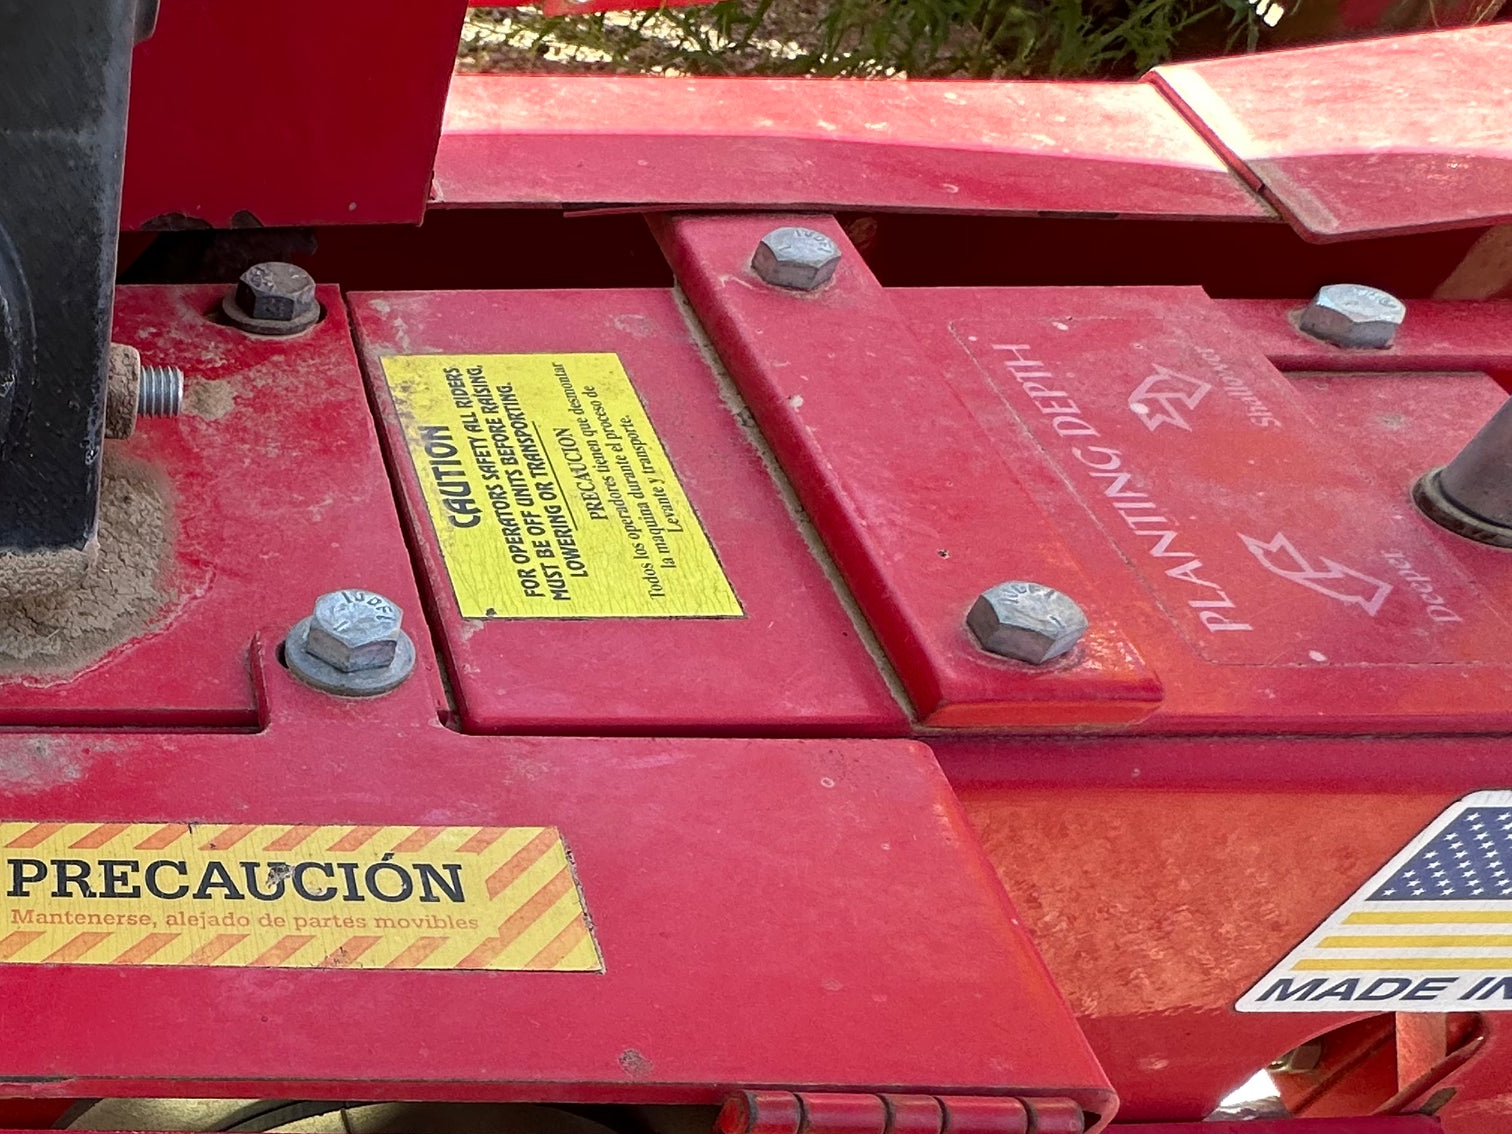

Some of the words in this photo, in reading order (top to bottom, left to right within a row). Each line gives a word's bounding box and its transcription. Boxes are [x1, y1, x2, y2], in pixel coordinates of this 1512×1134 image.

[443, 367, 476, 408] RIDERS
[552, 362, 585, 415] desmontar
[581, 385, 600, 398] de
[992, 343, 1099, 437] DEPTH
[1196, 345, 1282, 429] Shallower
[459, 412, 484, 432] ALL
[499, 382, 550, 478] TRANSPORTING.
[579, 418, 600, 436] que
[590, 401, 623, 439] proceso
[467, 436, 501, 480] SAFETY
[486, 418, 520, 465] BEFORE
[588, 440, 611, 473] tienen
[607, 442, 623, 452] el
[619, 415, 658, 474] transporte.
[417, 425, 482, 528] CAUTION
[509, 469, 537, 506] UNITS
[535, 481, 556, 501] OR
[553, 427, 608, 520] PRECAUCION
[617, 454, 646, 499] durante
[485, 484, 530, 564] OPERATORS
[520, 510, 546, 535] OFF
[603, 476, 644, 540] operadores
[639, 502, 670, 554] maquina
[651, 487, 684, 533] Levante
[533, 540, 556, 558] BE
[544, 505, 588, 577] LOWERING
[630, 543, 648, 559] los
[1072, 446, 1253, 633] PLANTING
[514, 569, 545, 597] FOR
[541, 562, 571, 601] MUST
[639, 562, 666, 599] Todos
[661, 558, 676, 569] la
[6, 852, 467, 903] PRECAUCIÓN
[11, 909, 157, 929] Mantenerse,
[165, 910, 250, 931] alejado
[258, 912, 286, 929] de
[294, 915, 367, 934] partes
[373, 914, 479, 932] movibles
[1256, 977, 1459, 1001] MADE
